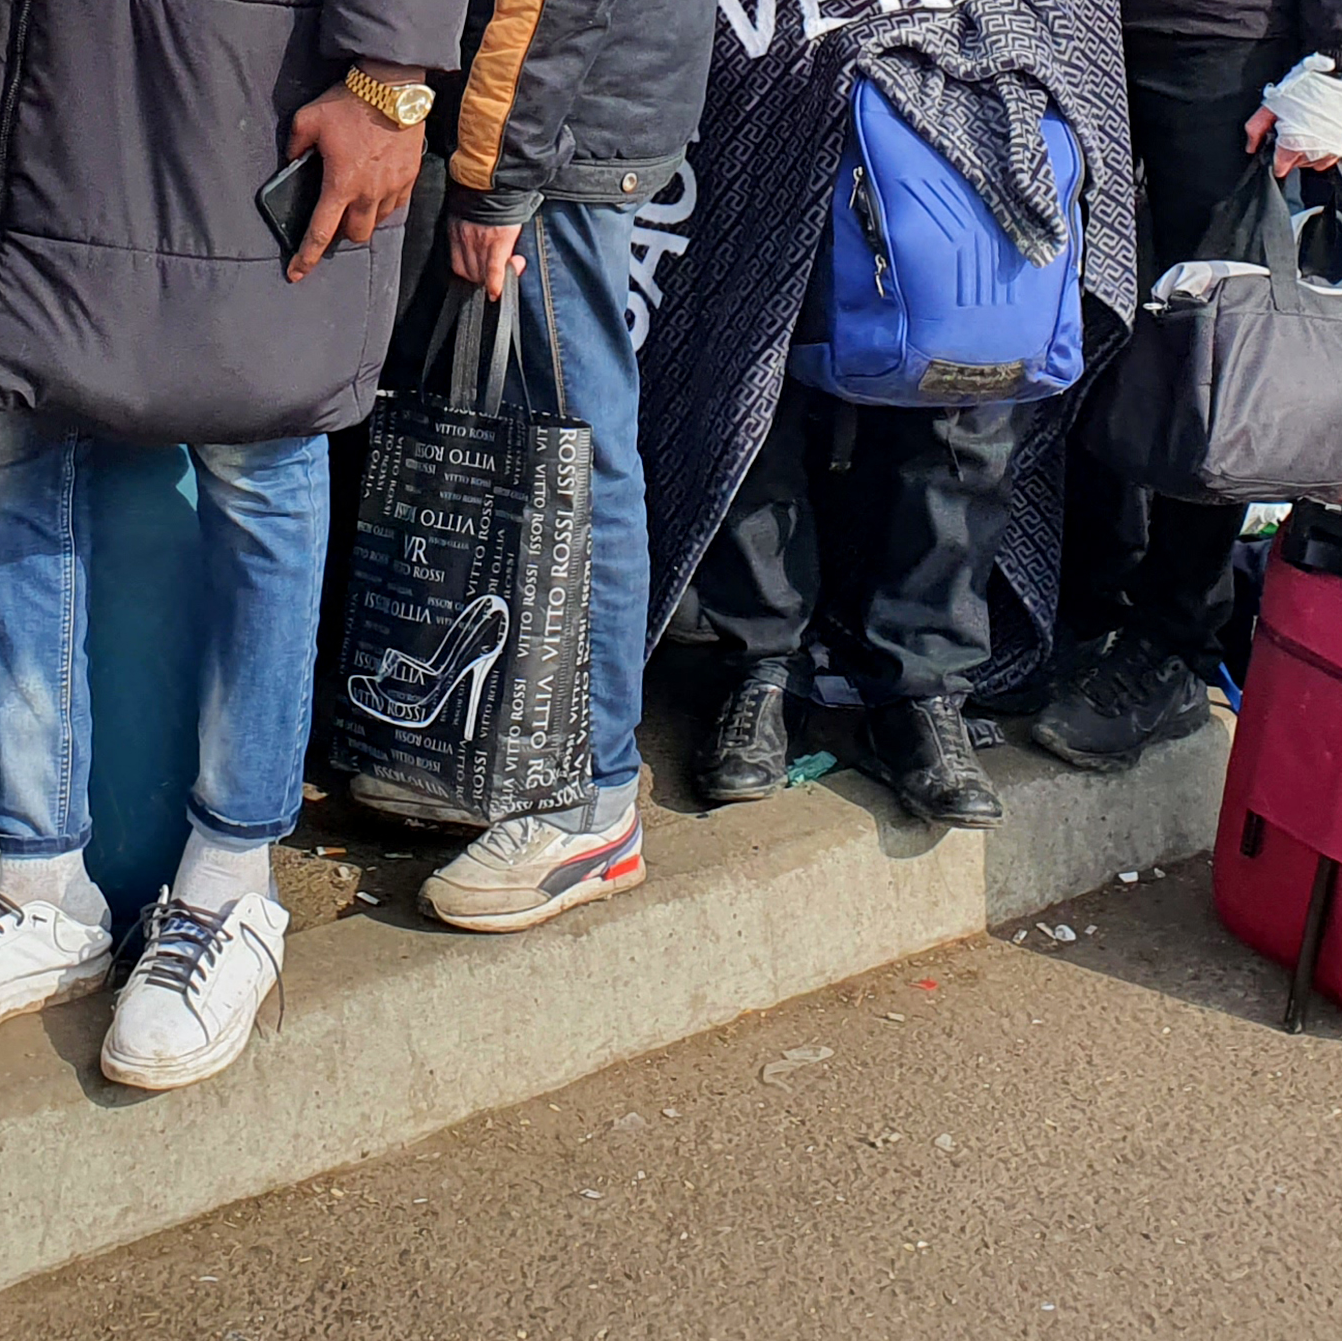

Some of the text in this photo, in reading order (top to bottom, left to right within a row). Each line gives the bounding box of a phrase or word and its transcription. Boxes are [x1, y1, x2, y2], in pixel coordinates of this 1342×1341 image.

[435, 422, 467, 438] VITTO
[449, 448, 497, 472] VITTO
[557, 428, 579, 496] ROSSI
[420, 509, 476, 535] VITTO
[528, 463, 548, 556] VITTO ROSSI
[403, 533, 430, 565] VR
[466, 493, 496, 596] VITTO ROSSI
[492, 528, 507, 574] VITTO
[413, 566, 446, 583] ROSSI
[542, 510, 574, 662] VITTO ROSSI
[391, 601, 432, 624] VITTO
[517, 564, 540, 659] VITTO ROSSI
[387, 701, 427, 722] ROSSI
[505, 678, 528, 772] VITTO ROSSI
[529, 674, 556, 749] VITTO
[424, 736, 454, 755] VITTO
[472, 749, 489, 800] ROSSI
